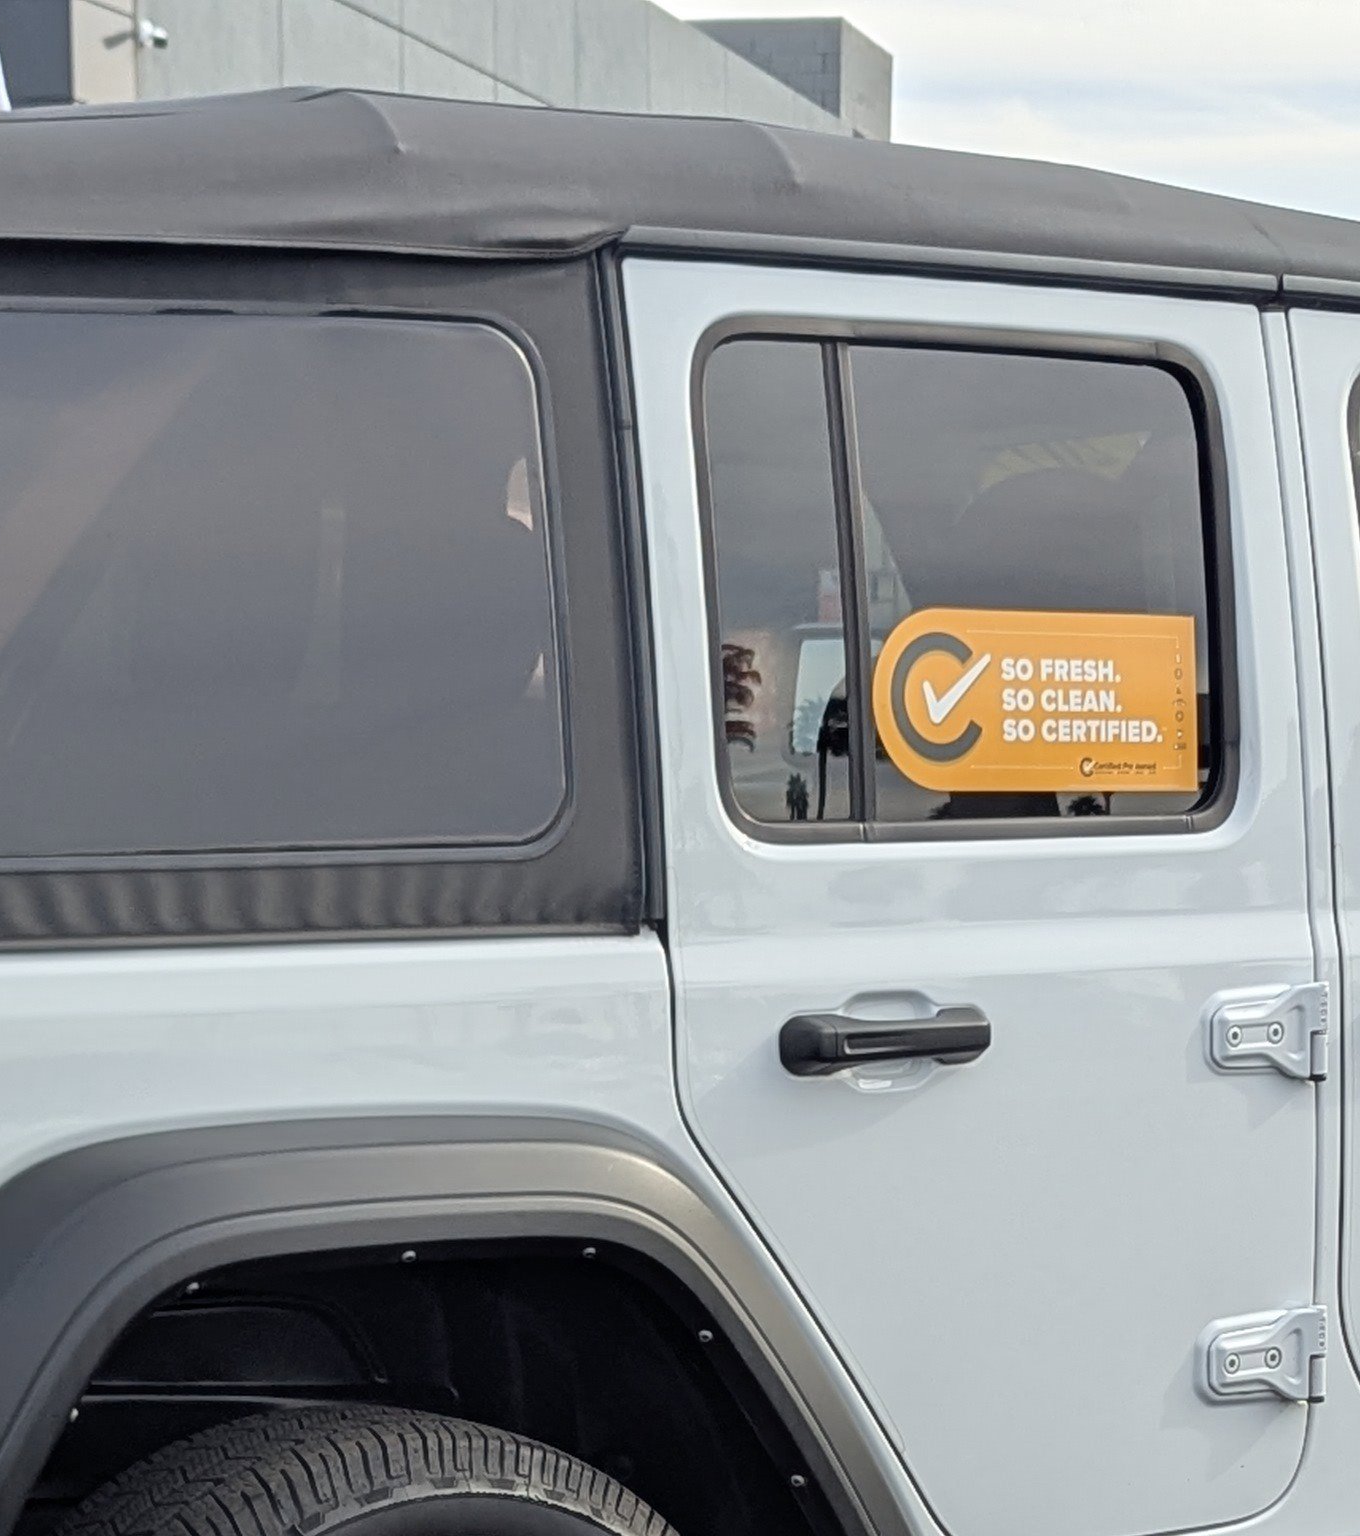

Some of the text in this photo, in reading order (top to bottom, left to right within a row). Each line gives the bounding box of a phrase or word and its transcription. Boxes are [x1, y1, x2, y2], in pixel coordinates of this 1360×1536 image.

[1001, 658, 1121, 683] SO FRESH.
[1002, 688, 1123, 713] SO CLEAN.
[1003, 719, 1163, 743] SO CERTIFIED.
